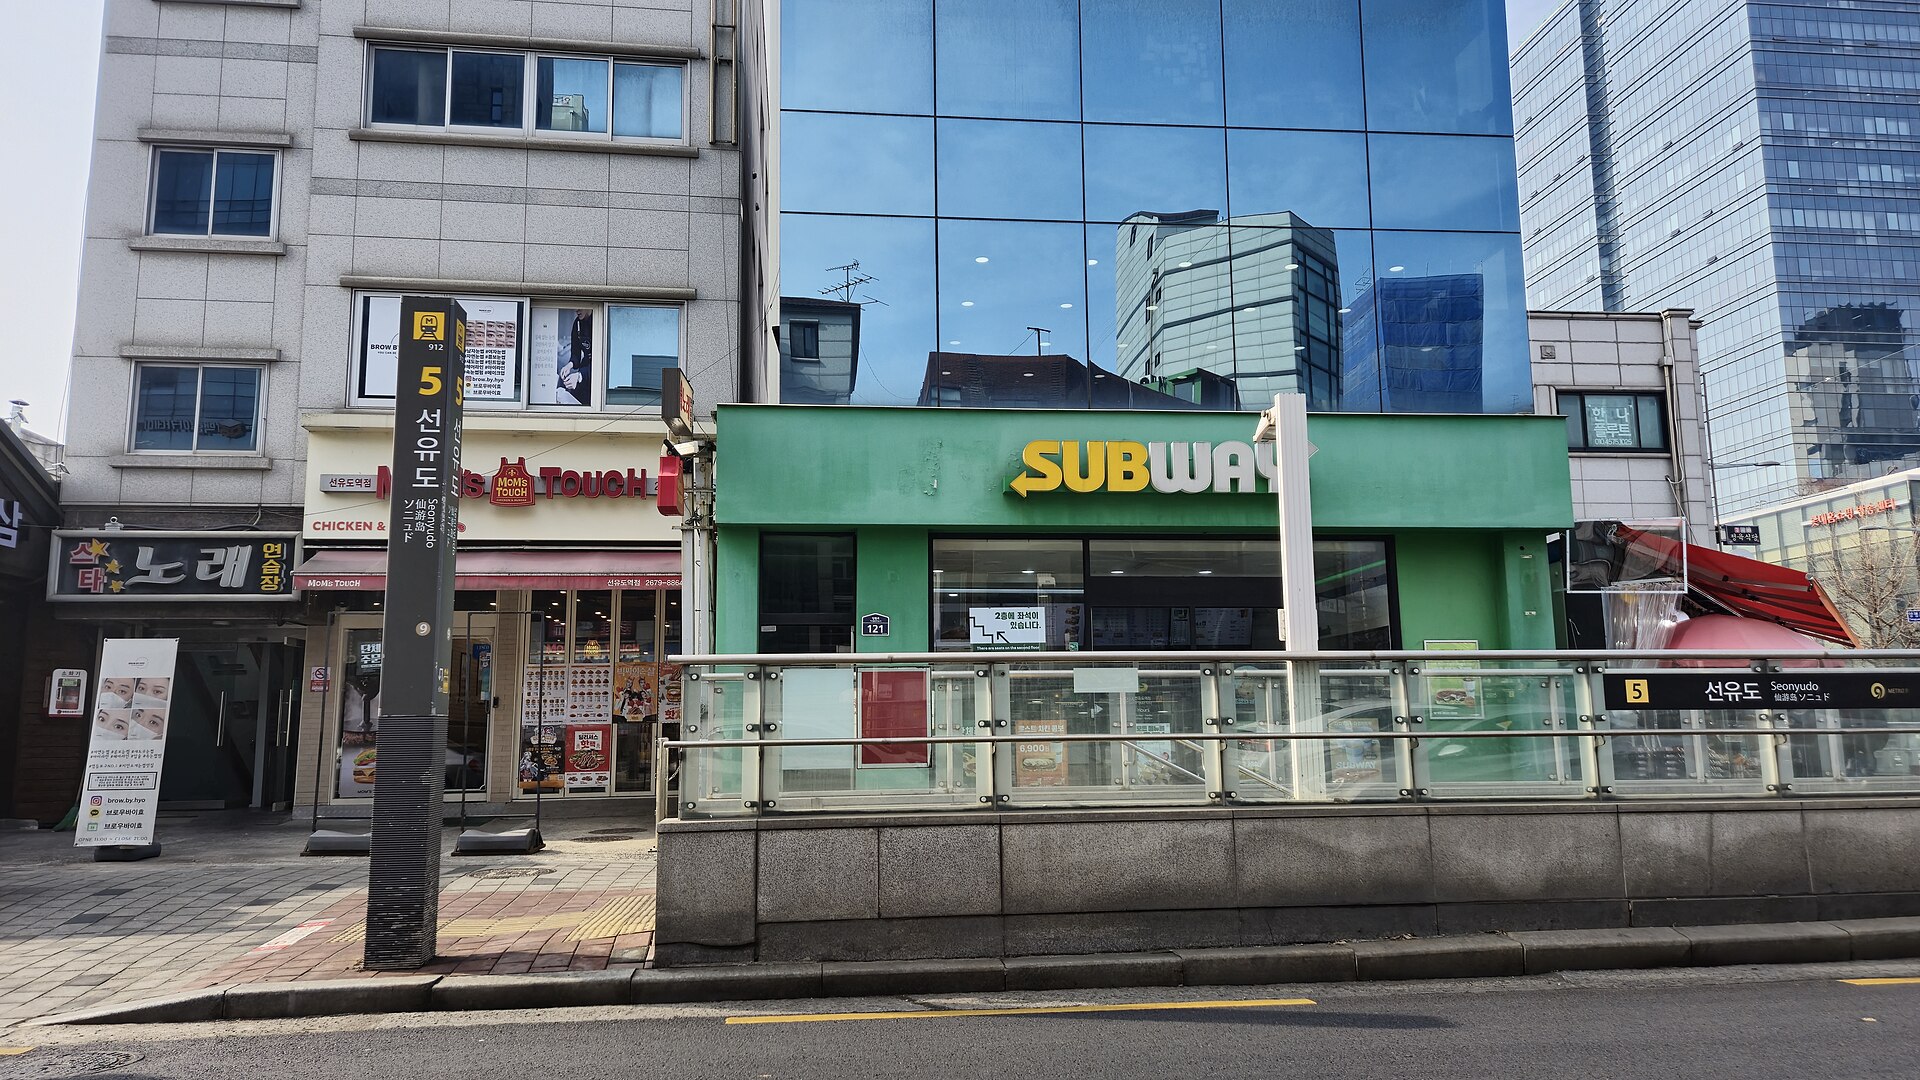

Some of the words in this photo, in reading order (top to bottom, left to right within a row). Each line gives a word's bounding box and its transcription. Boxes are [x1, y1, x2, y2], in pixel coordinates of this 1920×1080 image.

[418, 366, 442, 396] 5
[1593, 422, 1632, 438] 플루트
[412, 408, 441, 488] 선유도
[1009, 440, 1319, 498] SUBWAY
[329, 478, 372, 488] 선유도역점
[540, 467, 647, 500] TOUCH
[496, 487, 527, 497] TOUCH
[312, 521, 373, 531] CHICKEN
[376, 521, 386, 531] &
[425, 498, 438, 549] Seonyudo
[69, 541, 108, 593] 스타
[124, 545, 253, 588] 노래
[260, 542, 287, 592] 연습장
[607, 579, 641, 587] 선유도역점
[994, 612, 1015, 620] 2층에
[1017, 611, 1039, 620] 좌석이
[420, 624, 428, 634] 9
[867, 624, 884, 634] 121
[1010, 621, 1041, 629] 있습니다.
[361, 643, 381, 653] 단체
[1632, 683, 1642, 699] 5
[1704, 681, 1763, 702] 선유도
[1770, 681, 1819, 693] Seonyudo
[1335, 761, 1377, 769] SUBWAY
